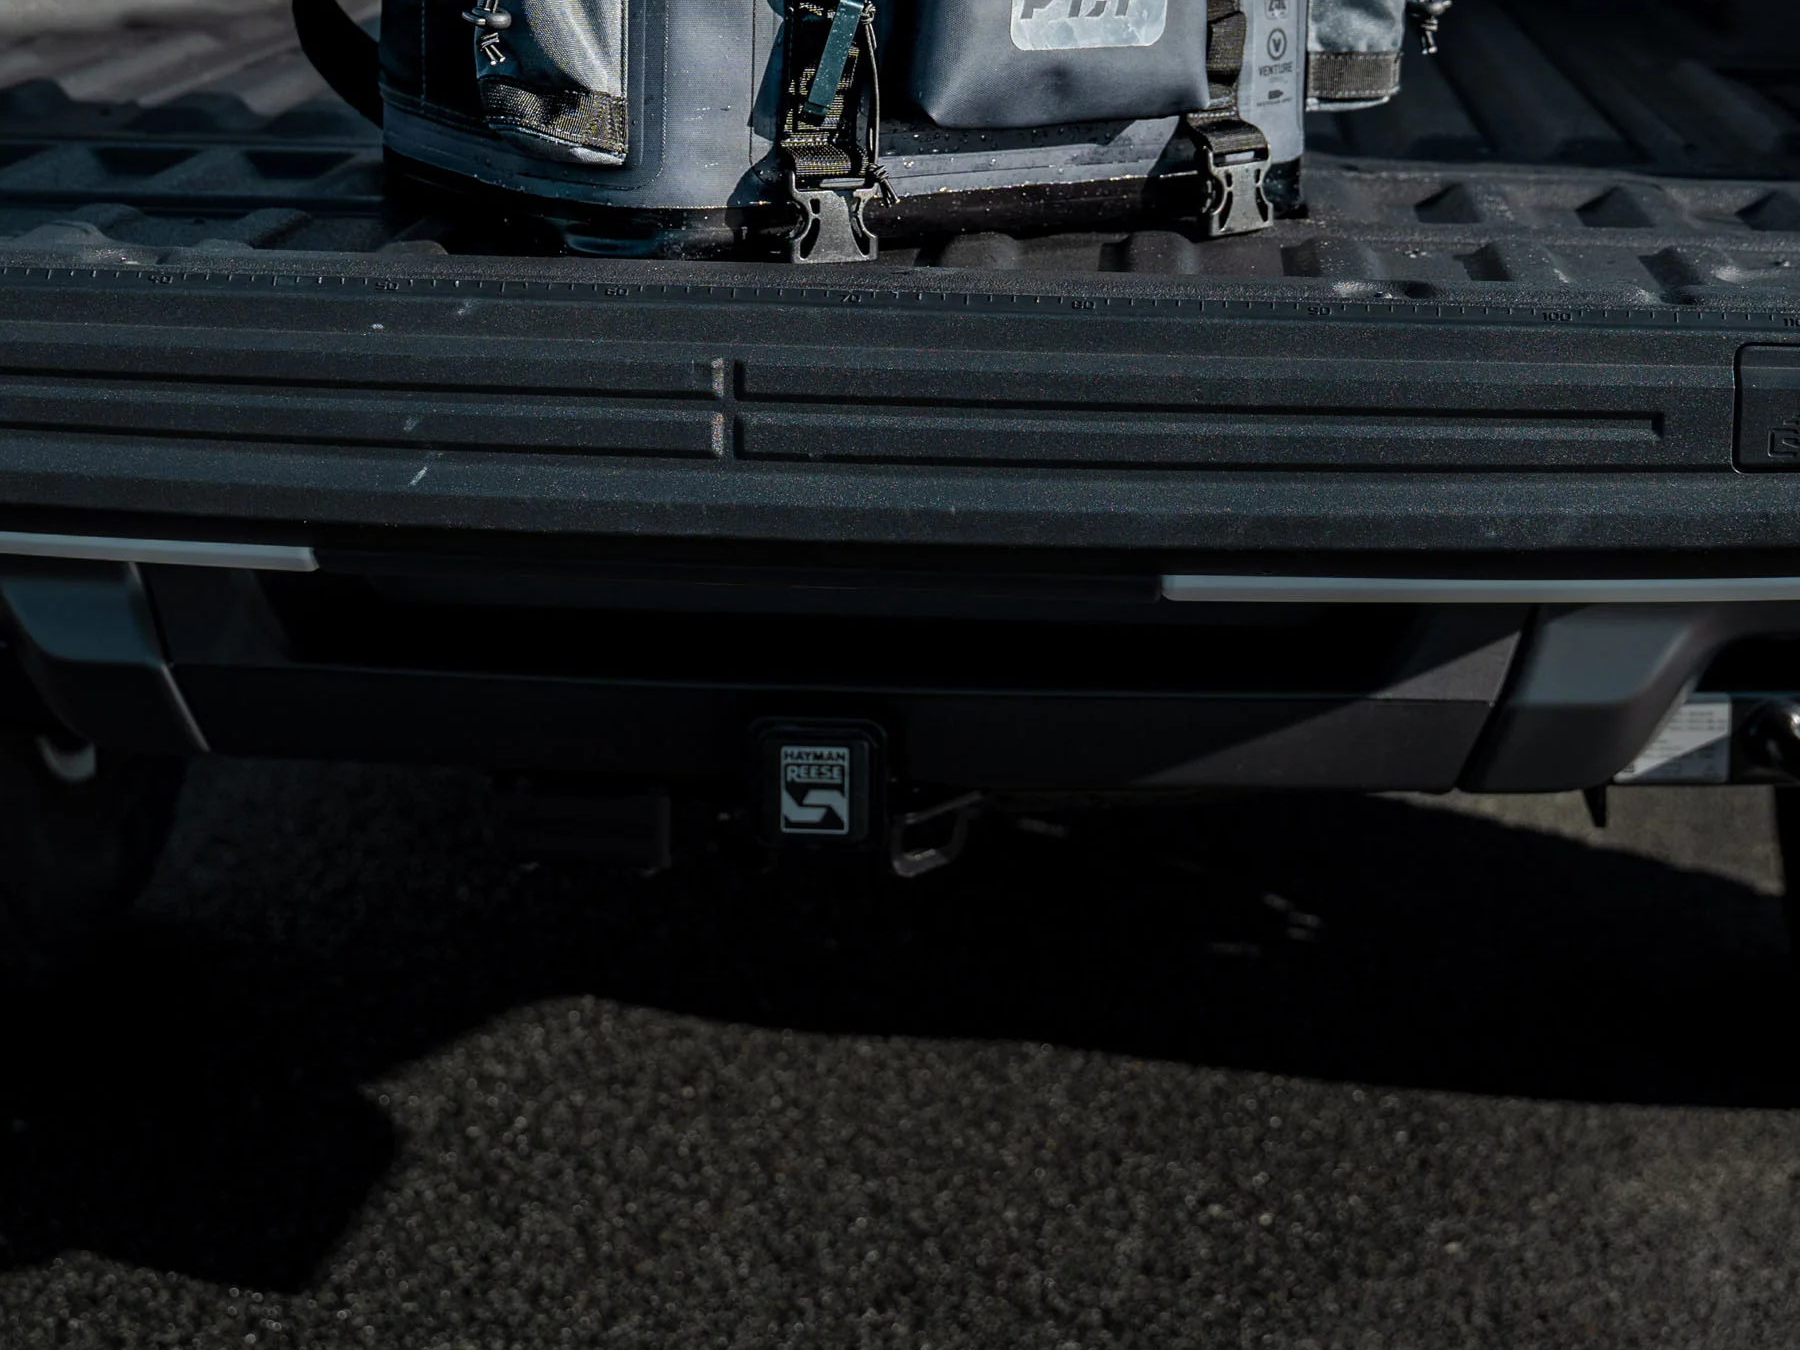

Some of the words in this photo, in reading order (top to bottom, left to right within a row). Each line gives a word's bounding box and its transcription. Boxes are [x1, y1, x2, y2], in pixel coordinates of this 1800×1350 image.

[1258, 61, 1293, 77] VENTURE
[1543, 311, 1573, 322] 100
[784, 750, 846, 762] HAYMAN
[786, 765, 843, 783] REESE
